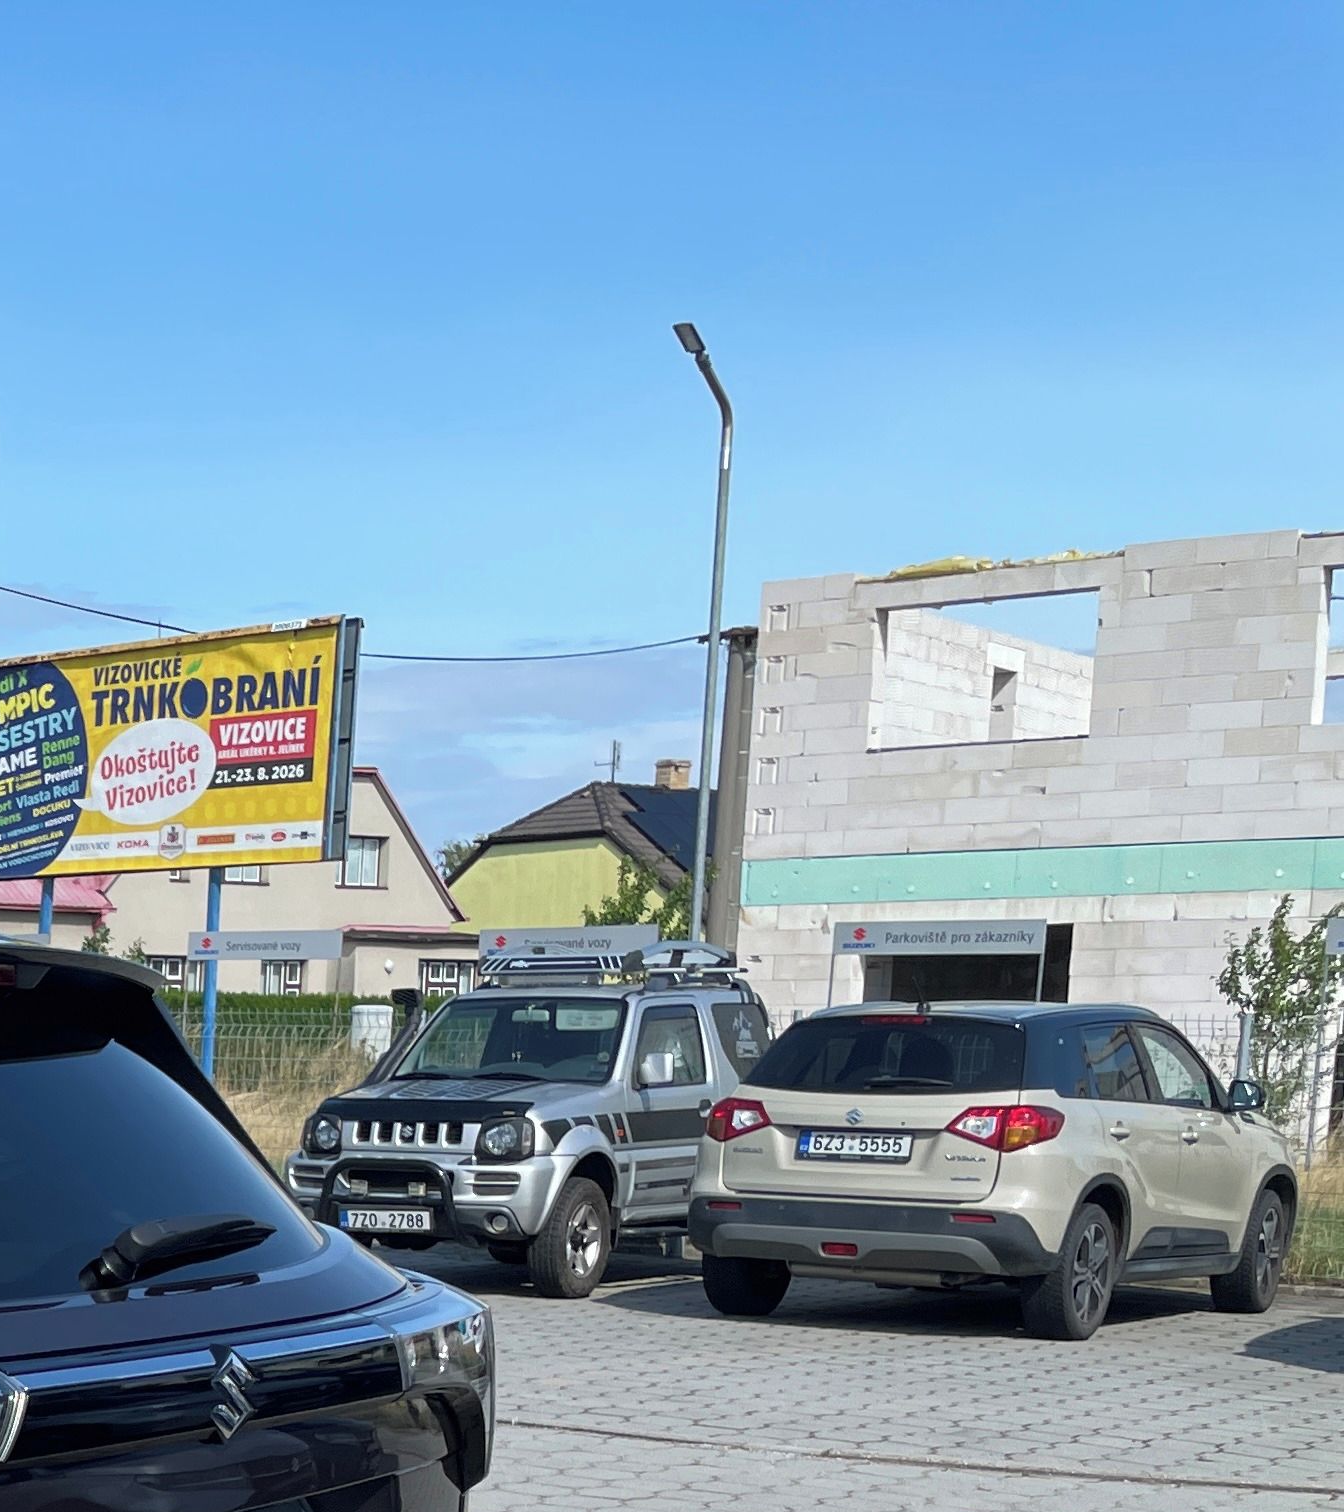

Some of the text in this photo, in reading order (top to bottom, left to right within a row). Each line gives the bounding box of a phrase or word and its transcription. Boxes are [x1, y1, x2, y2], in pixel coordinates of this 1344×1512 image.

[93, 651, 182, 687] VIZOVICKÉ
[17, 670, 28, 688] X
[219, 717, 307, 746] VIZOVICE
[42, 735, 80, 755] Renne
[43, 751, 75, 769] Dang
[100, 741, 200, 780] Okoštujte
[44, 764, 84, 785] Premier
[256, 767, 270, 781] 8.
[271, 764, 305, 779] 2026
[15, 790, 51, 809] Vlasta
[52, 780, 80, 799] Redl
[105, 768, 197, 811] Vizovice!
[116, 839, 150, 850] KOMA
[225, 941, 301, 952] Servisované vozy
[587, 938, 612, 950] vozy
[885, 930, 1035, 945] Parkoviště pro zákazníky
[812, 1134, 903, 1154] 6Z3 5555
[388, 1213, 424, 1229] 2788
